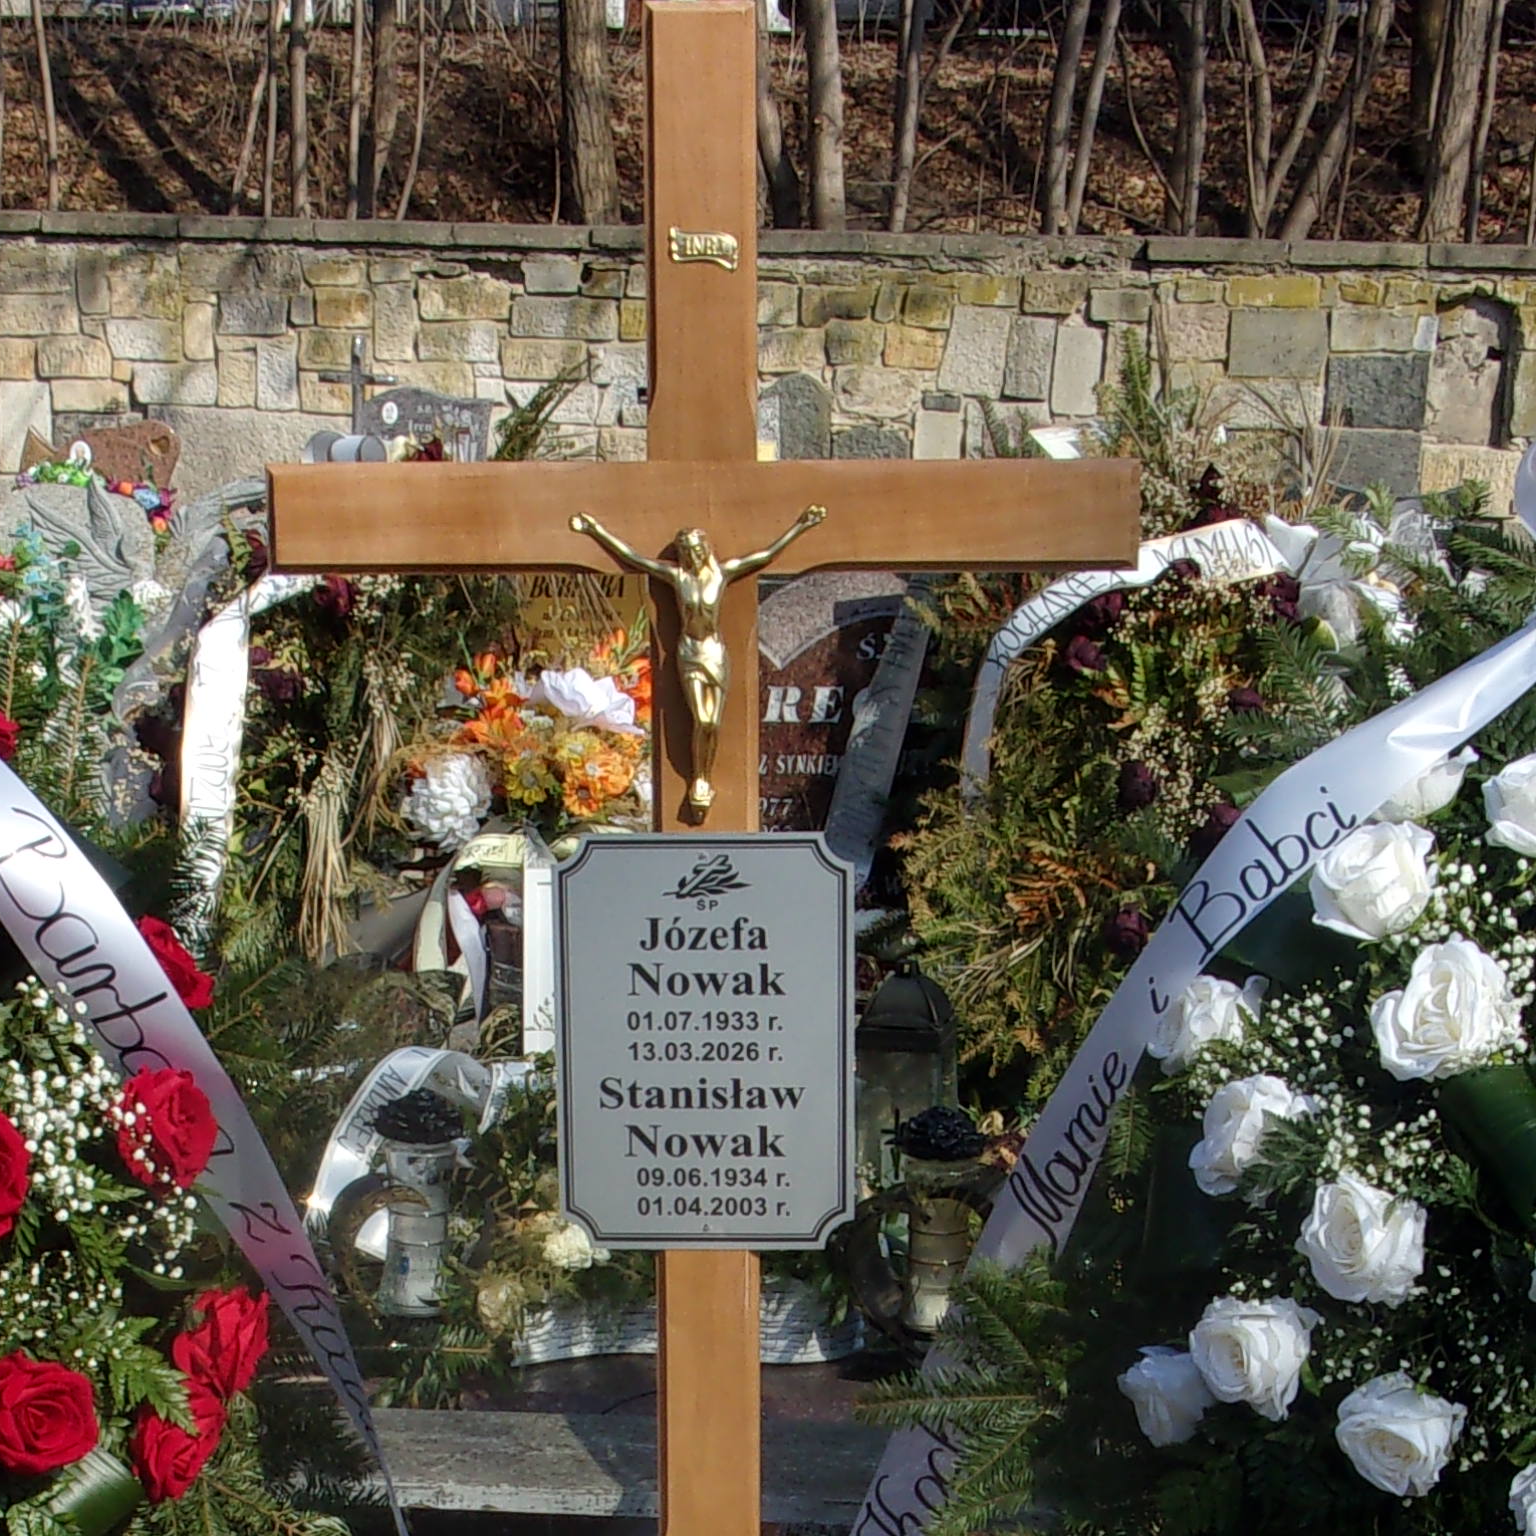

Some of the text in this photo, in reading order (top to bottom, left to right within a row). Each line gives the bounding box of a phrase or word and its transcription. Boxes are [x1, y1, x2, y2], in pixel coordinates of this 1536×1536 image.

[639, 916, 769, 952] Józefa
[626, 962, 787, 997] Nowak
[626, 1010, 785, 1032] 01.07.1933 r.
[1006, 1048, 1130, 1247] Mamie
[1168, 785, 1359, 956] Babci
[627, 1041, 785, 1063] 13.03.2026 r.
[598, 1075, 807, 1111] Stanisław
[624, 1123, 787, 1159] Nowak
[636, 1166, 792, 1188] 09.06.1934 r.
[637, 1196, 792, 1218] 01.04.2003 r.
